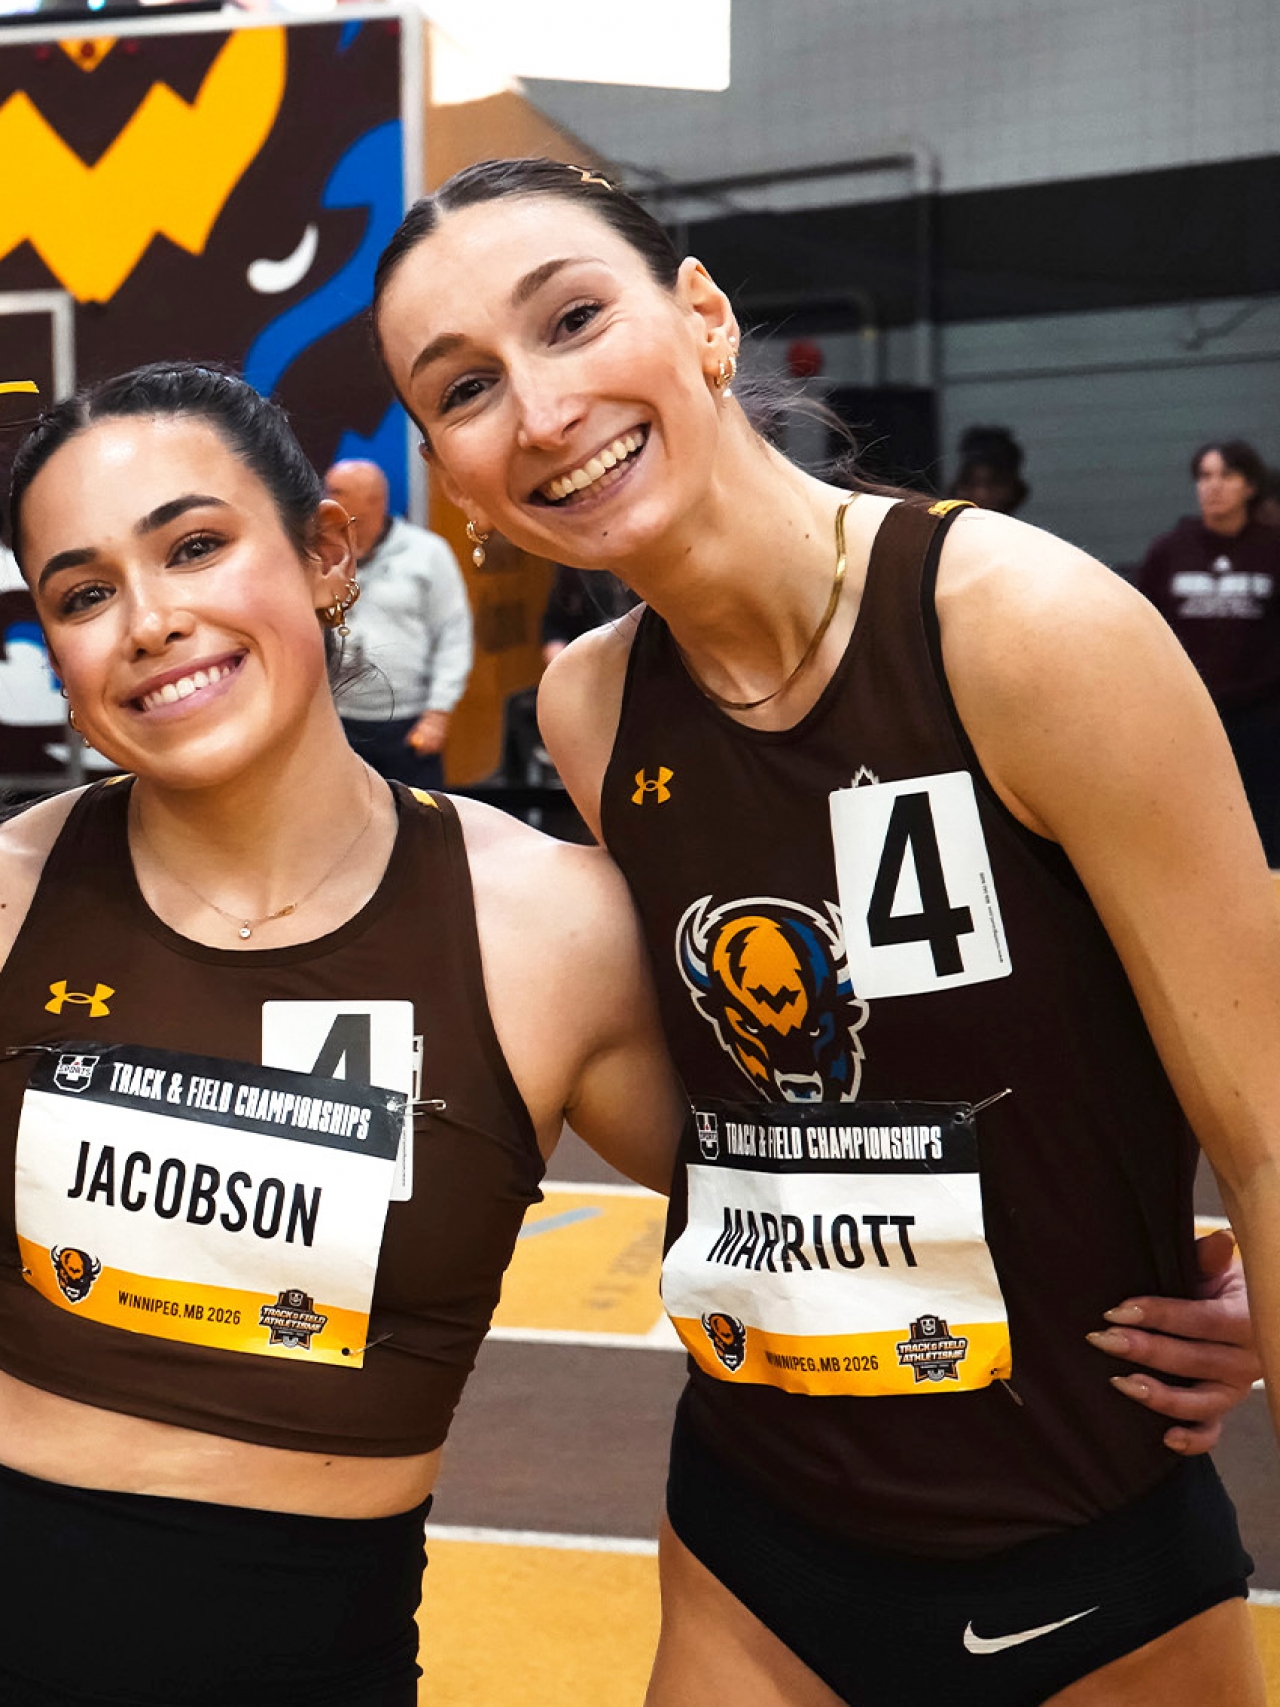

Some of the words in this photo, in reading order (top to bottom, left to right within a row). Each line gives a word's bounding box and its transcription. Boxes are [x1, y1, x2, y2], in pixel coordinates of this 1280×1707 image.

[867, 791, 975, 978] 4
[109, 1062, 166, 1101] TRACK
[166, 1072, 183, 1104] &
[186, 1076, 234, 1113] FIELD
[234, 1085, 372, 1140] CHAMPIONSHIPS
[726, 1122, 757, 1157] TRACK
[758, 1125, 767, 1158] &
[768, 1126, 803, 1159] FIELD
[806, 1126, 942, 1160] CHAMPIONSHIPS
[67, 1140, 322, 1247] JACOBSON
[706, 1206, 918, 1273] MARRIOTT
[207, 1307, 241, 1325] 2026
[843, 1355, 879, 1372] 2026
